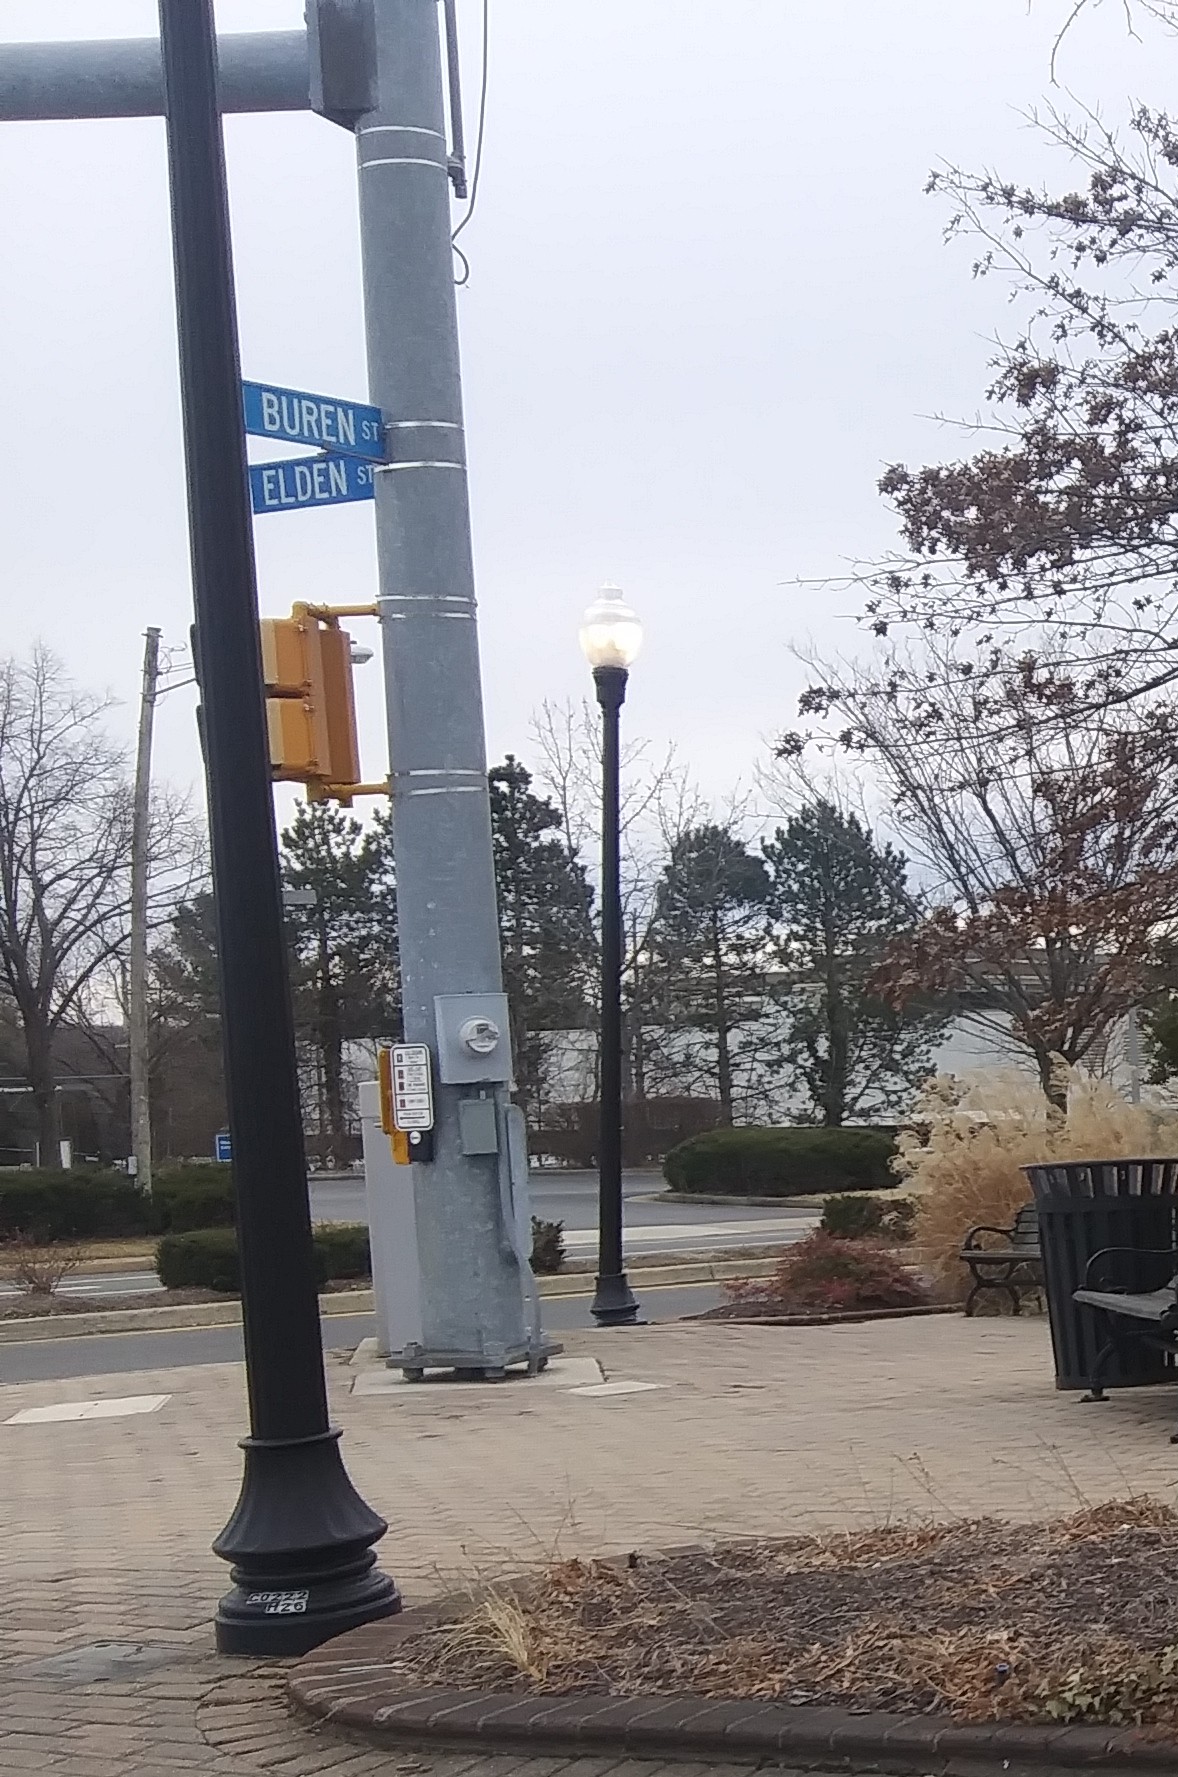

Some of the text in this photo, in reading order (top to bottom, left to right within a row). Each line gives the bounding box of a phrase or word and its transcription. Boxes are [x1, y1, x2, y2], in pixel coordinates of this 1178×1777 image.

[261, 391, 379, 446] BUREN ST
[261, 459, 374, 506] ELDEN ST
